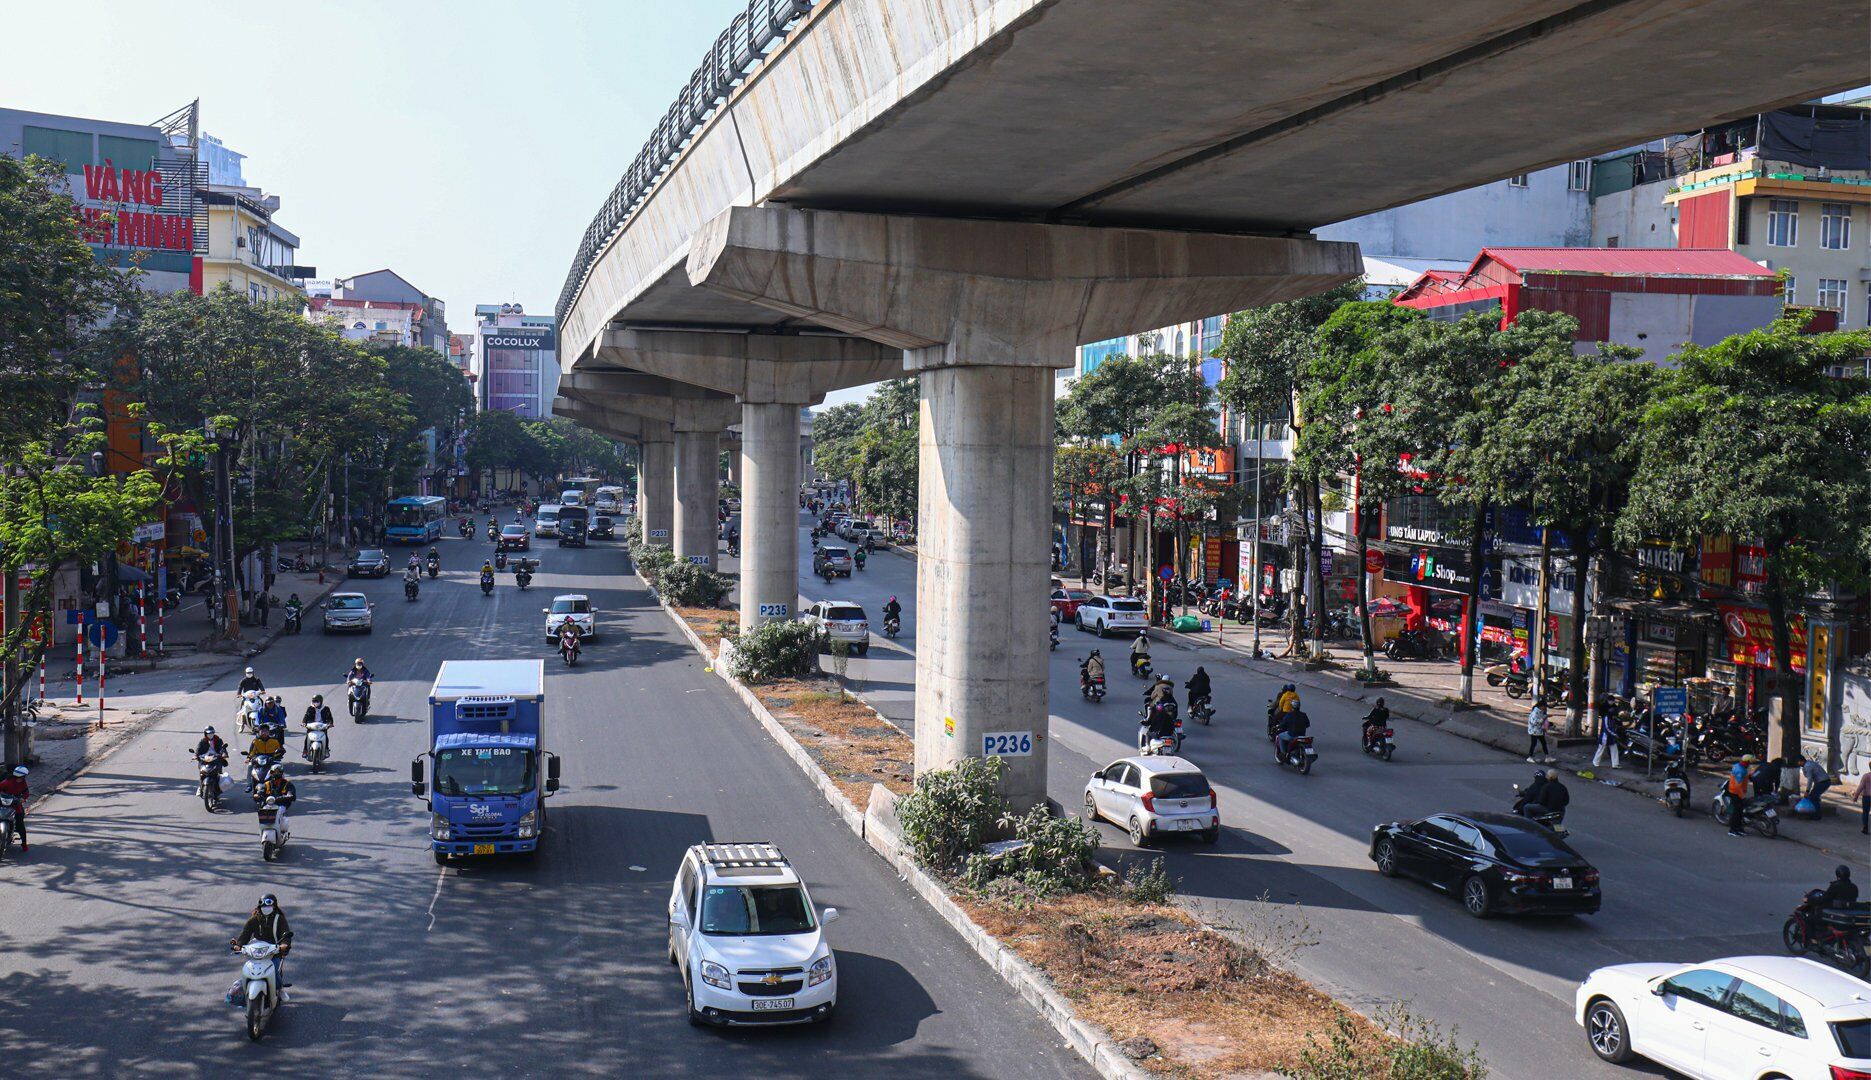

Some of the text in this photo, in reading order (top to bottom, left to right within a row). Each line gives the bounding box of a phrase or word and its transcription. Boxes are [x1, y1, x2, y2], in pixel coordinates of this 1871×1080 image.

[83, 158, 163, 206] VÀNG
[117, 210, 193, 251] MINH
[487, 337, 540, 347] COCOLUX
[1360, 508, 1379, 516] GP
[1404, 525, 1418, 543] TÂM
[1418, 529, 1440, 547] LAPTOP
[689, 556, 709, 565] P234
[1638, 549, 1684, 572] BAKERY
[760, 604, 787, 616] P235
[461, 748, 472, 756] XE
[984, 734, 1031, 755] P236
